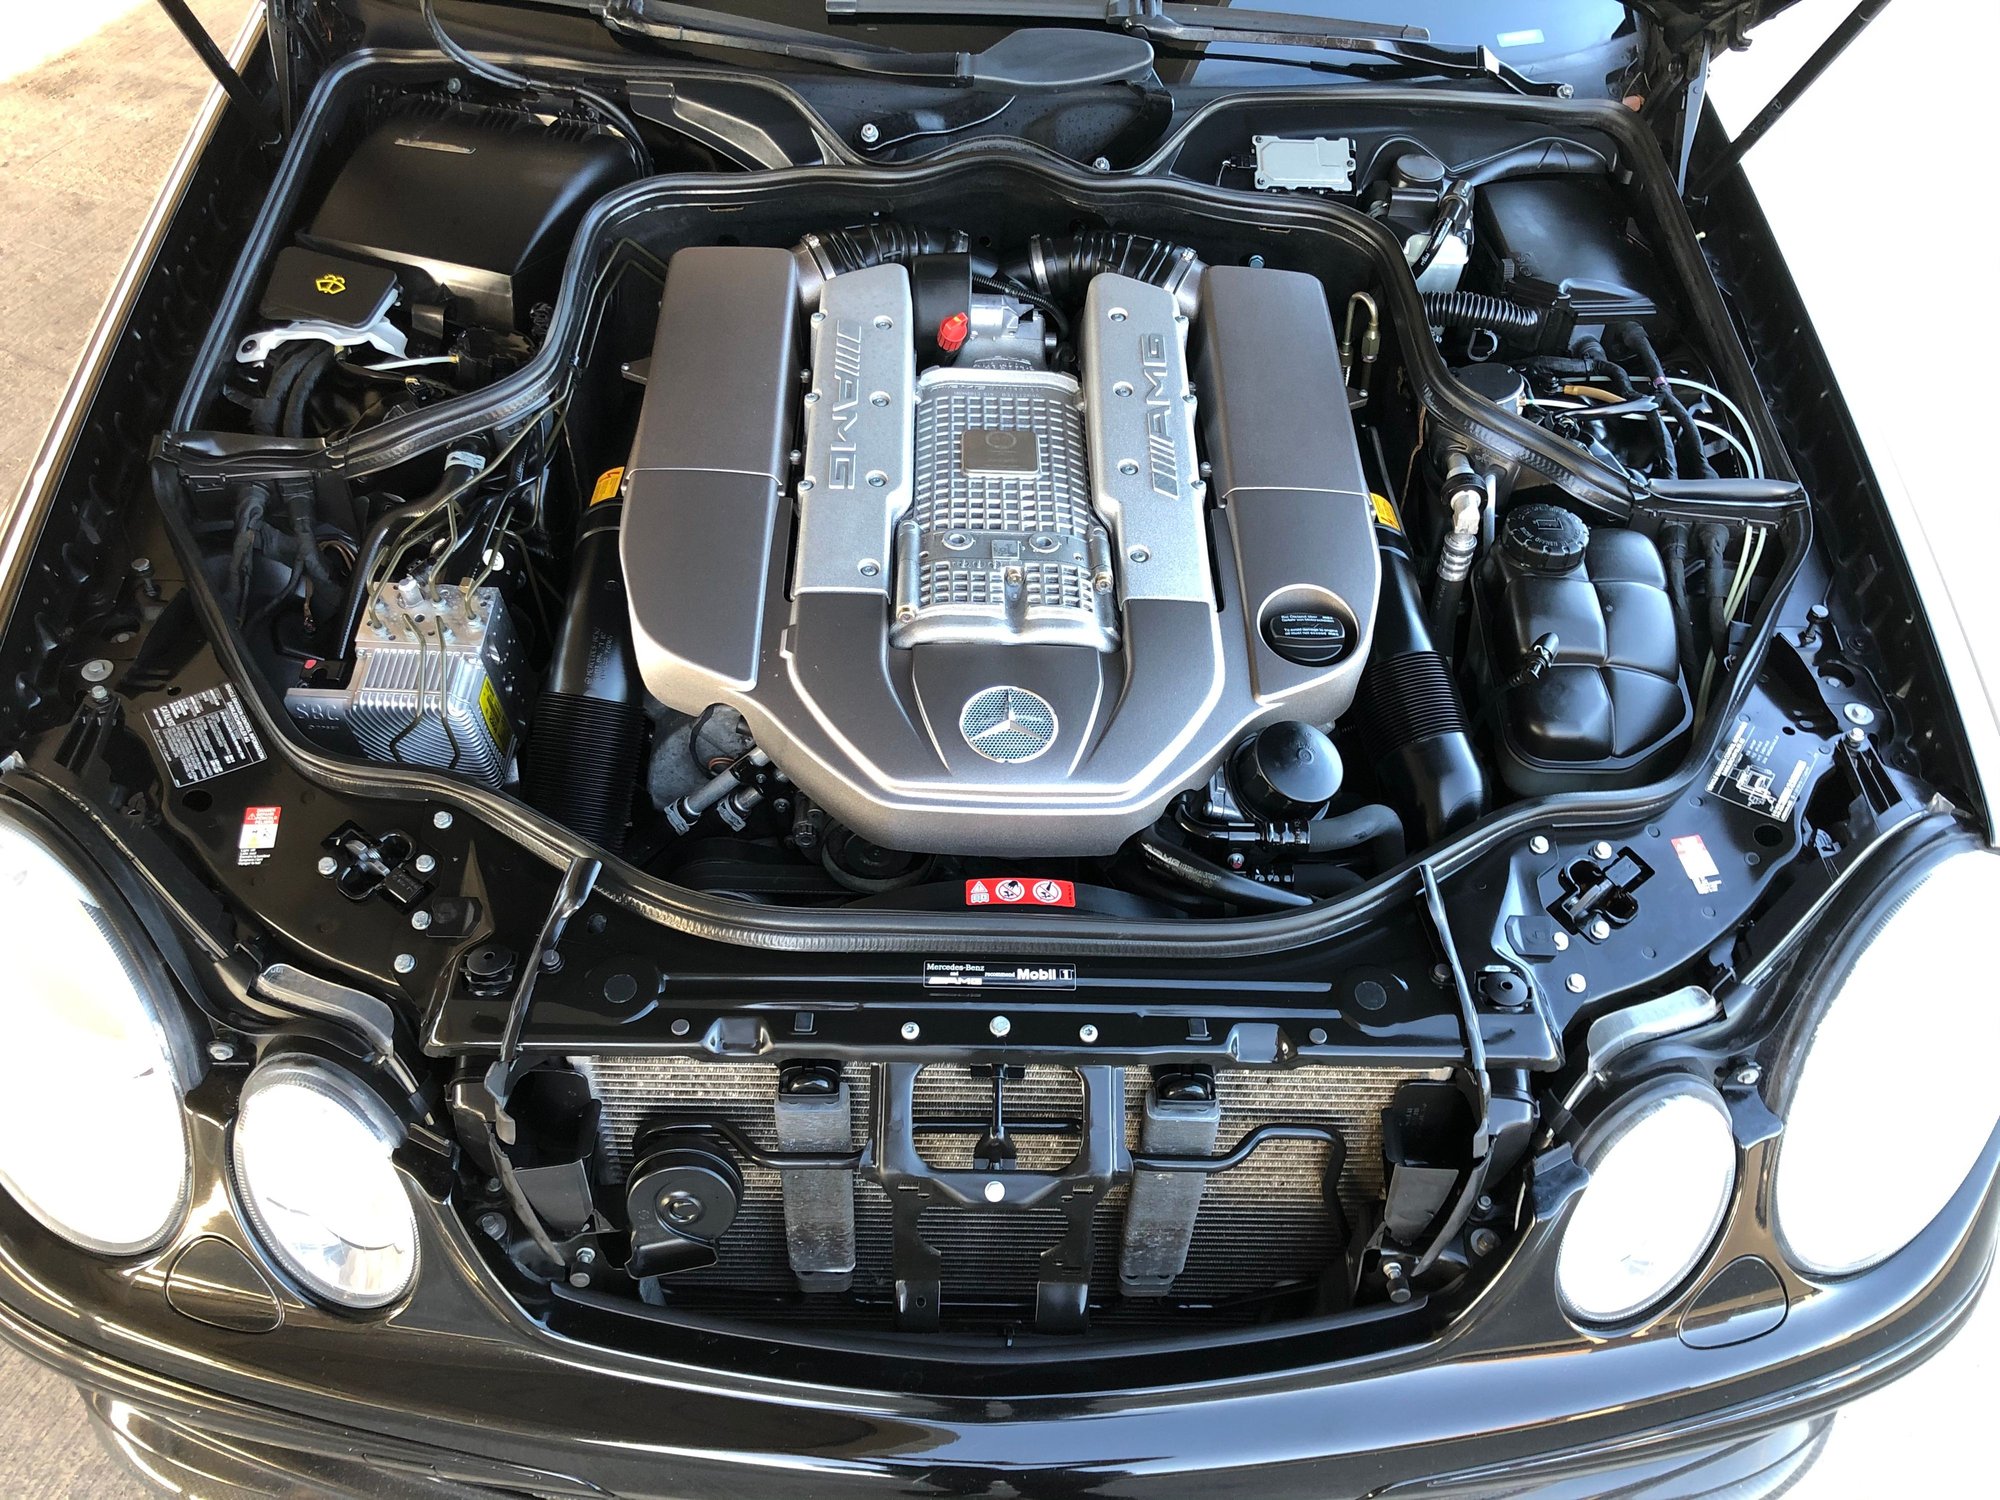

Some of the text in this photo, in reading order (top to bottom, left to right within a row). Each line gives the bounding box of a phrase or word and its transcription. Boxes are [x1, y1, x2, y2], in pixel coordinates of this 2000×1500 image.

[1140, 333, 1172, 440] AMG
[828, 372, 860, 489] AMG
[159, 705, 175, 727] CATALYST
[296, 703, 340, 721] SBC
[926, 963, 985, 972] Mercedes-Benz
[1017, 968, 1056, 980] Mobil
[929, 977, 983, 986] AMG
